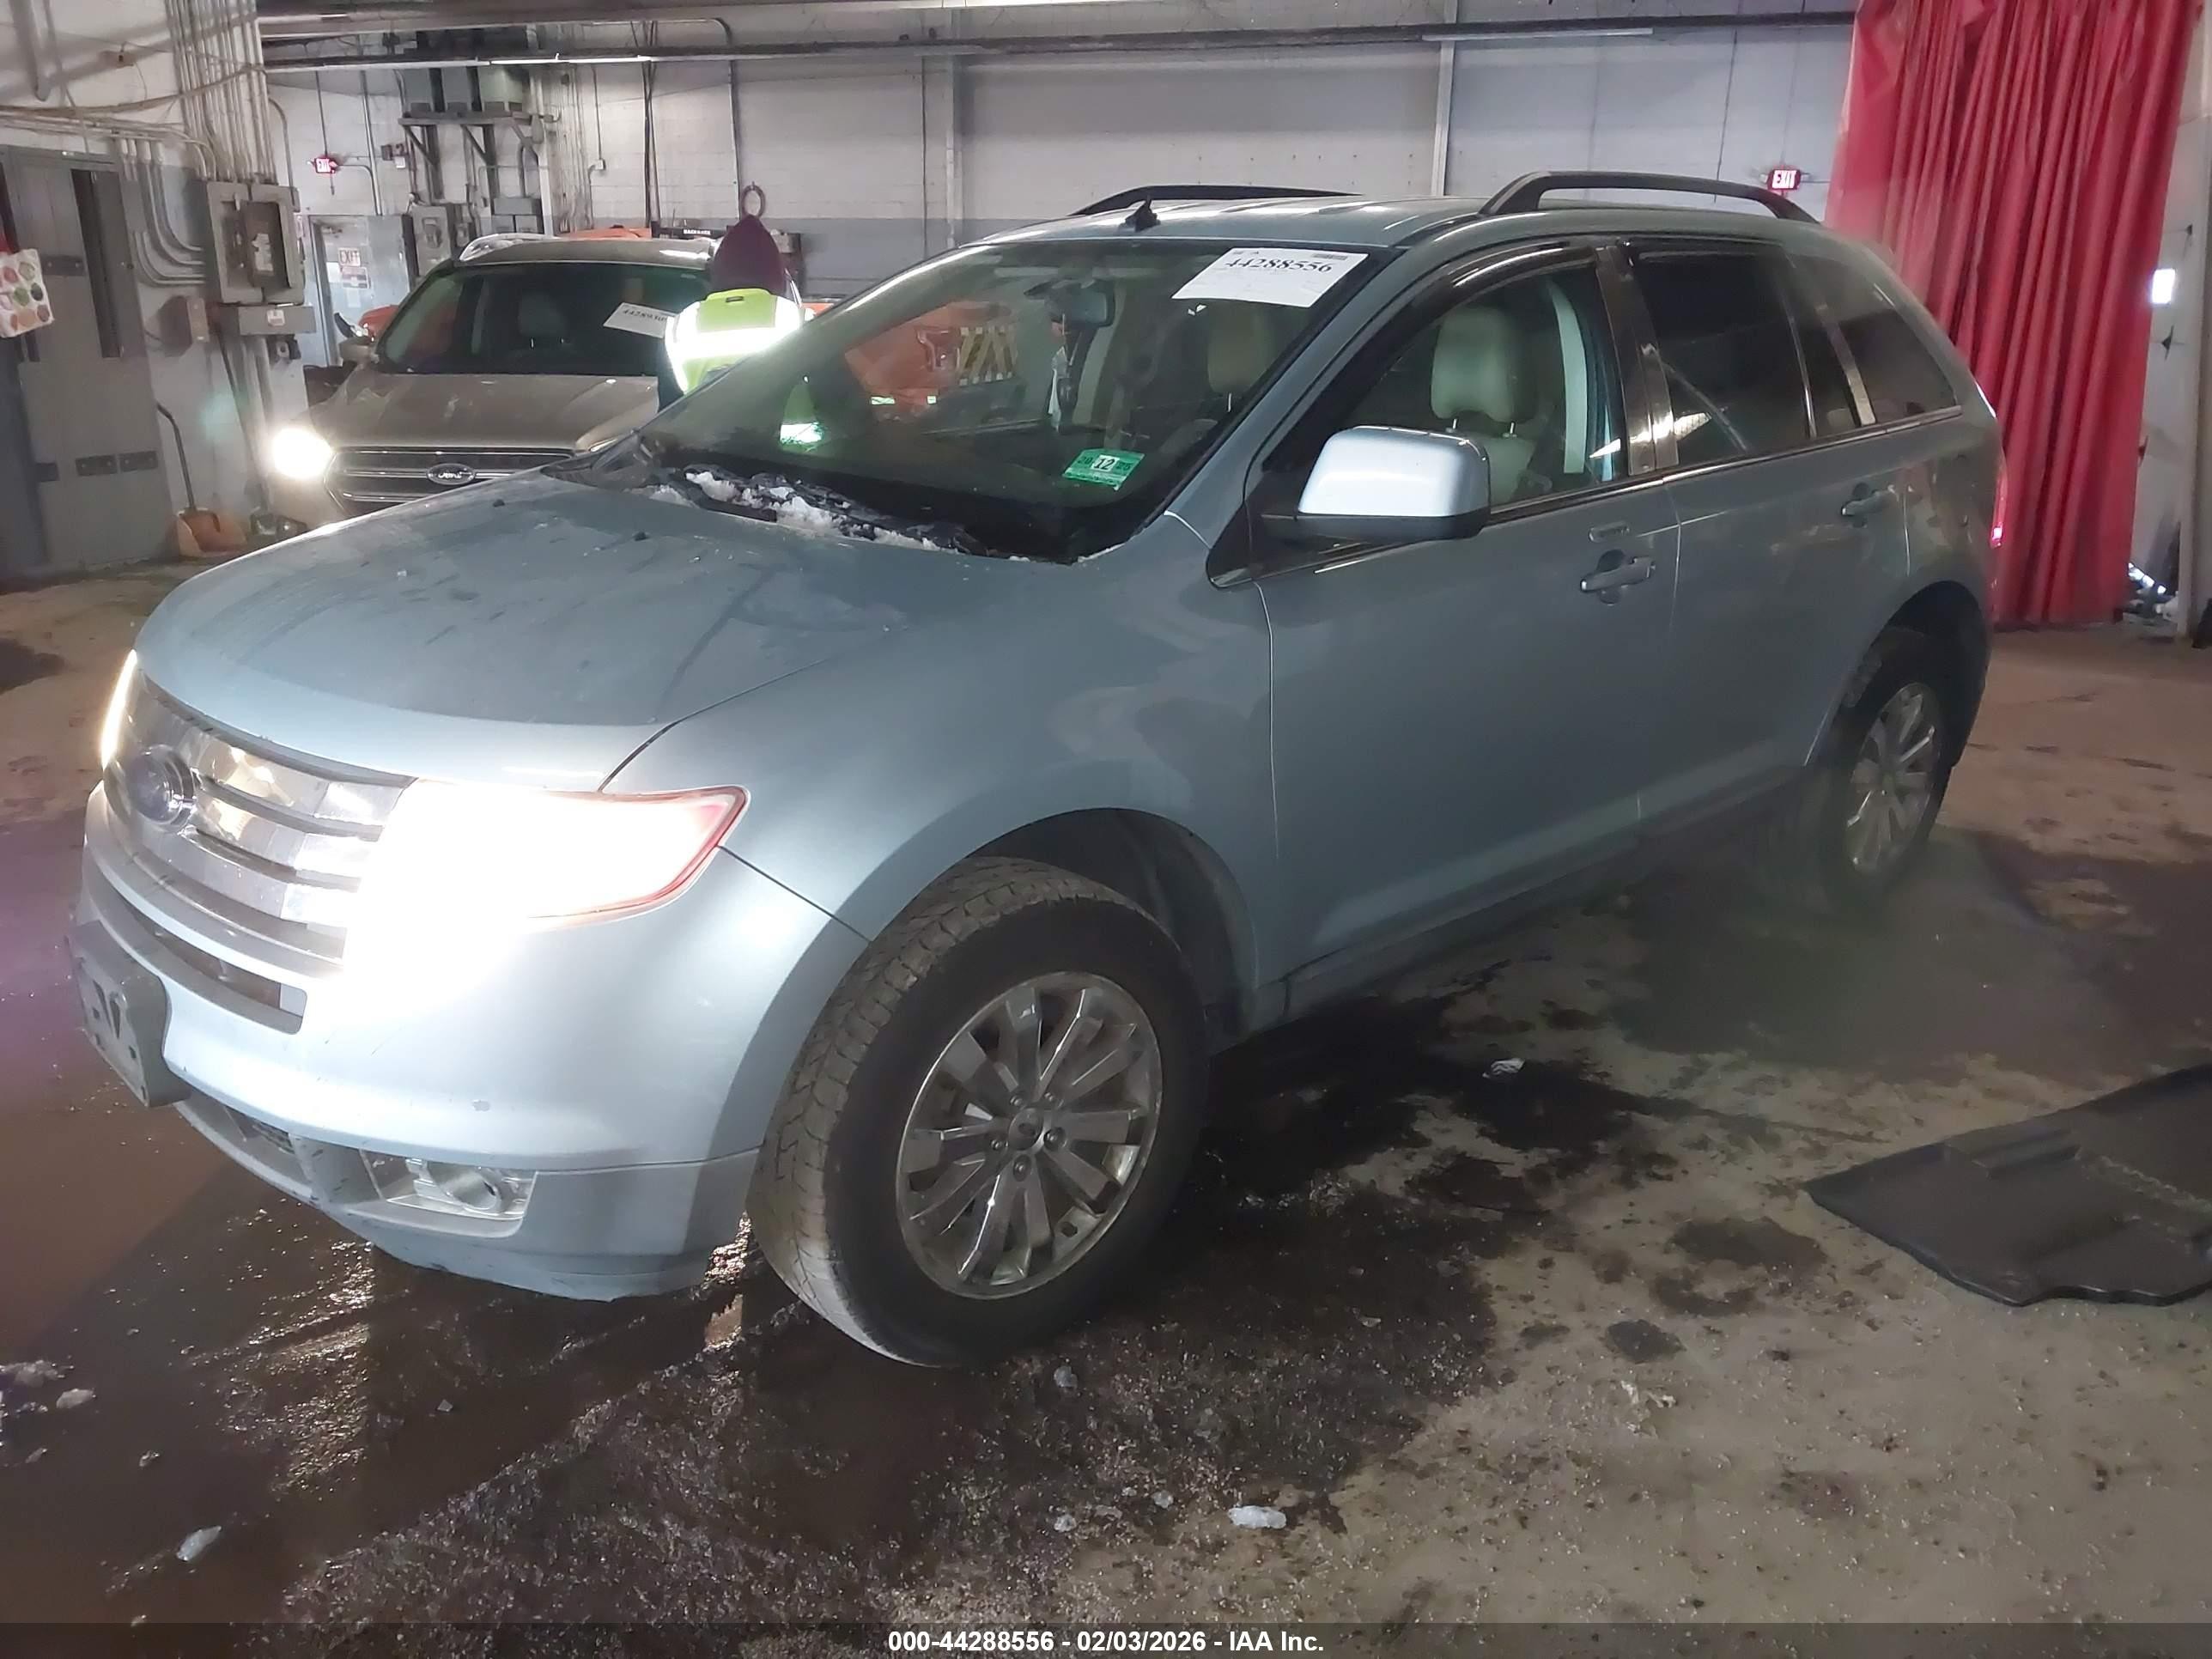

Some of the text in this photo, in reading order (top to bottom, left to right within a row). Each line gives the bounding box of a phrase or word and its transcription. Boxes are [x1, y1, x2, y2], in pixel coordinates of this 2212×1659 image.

[1772, 170, 1796, 188] EXIT
[339, 250, 359, 264] EXIT
[1224, 258, 1333, 273] 44288556
[1093, 458, 1115, 471] 12
